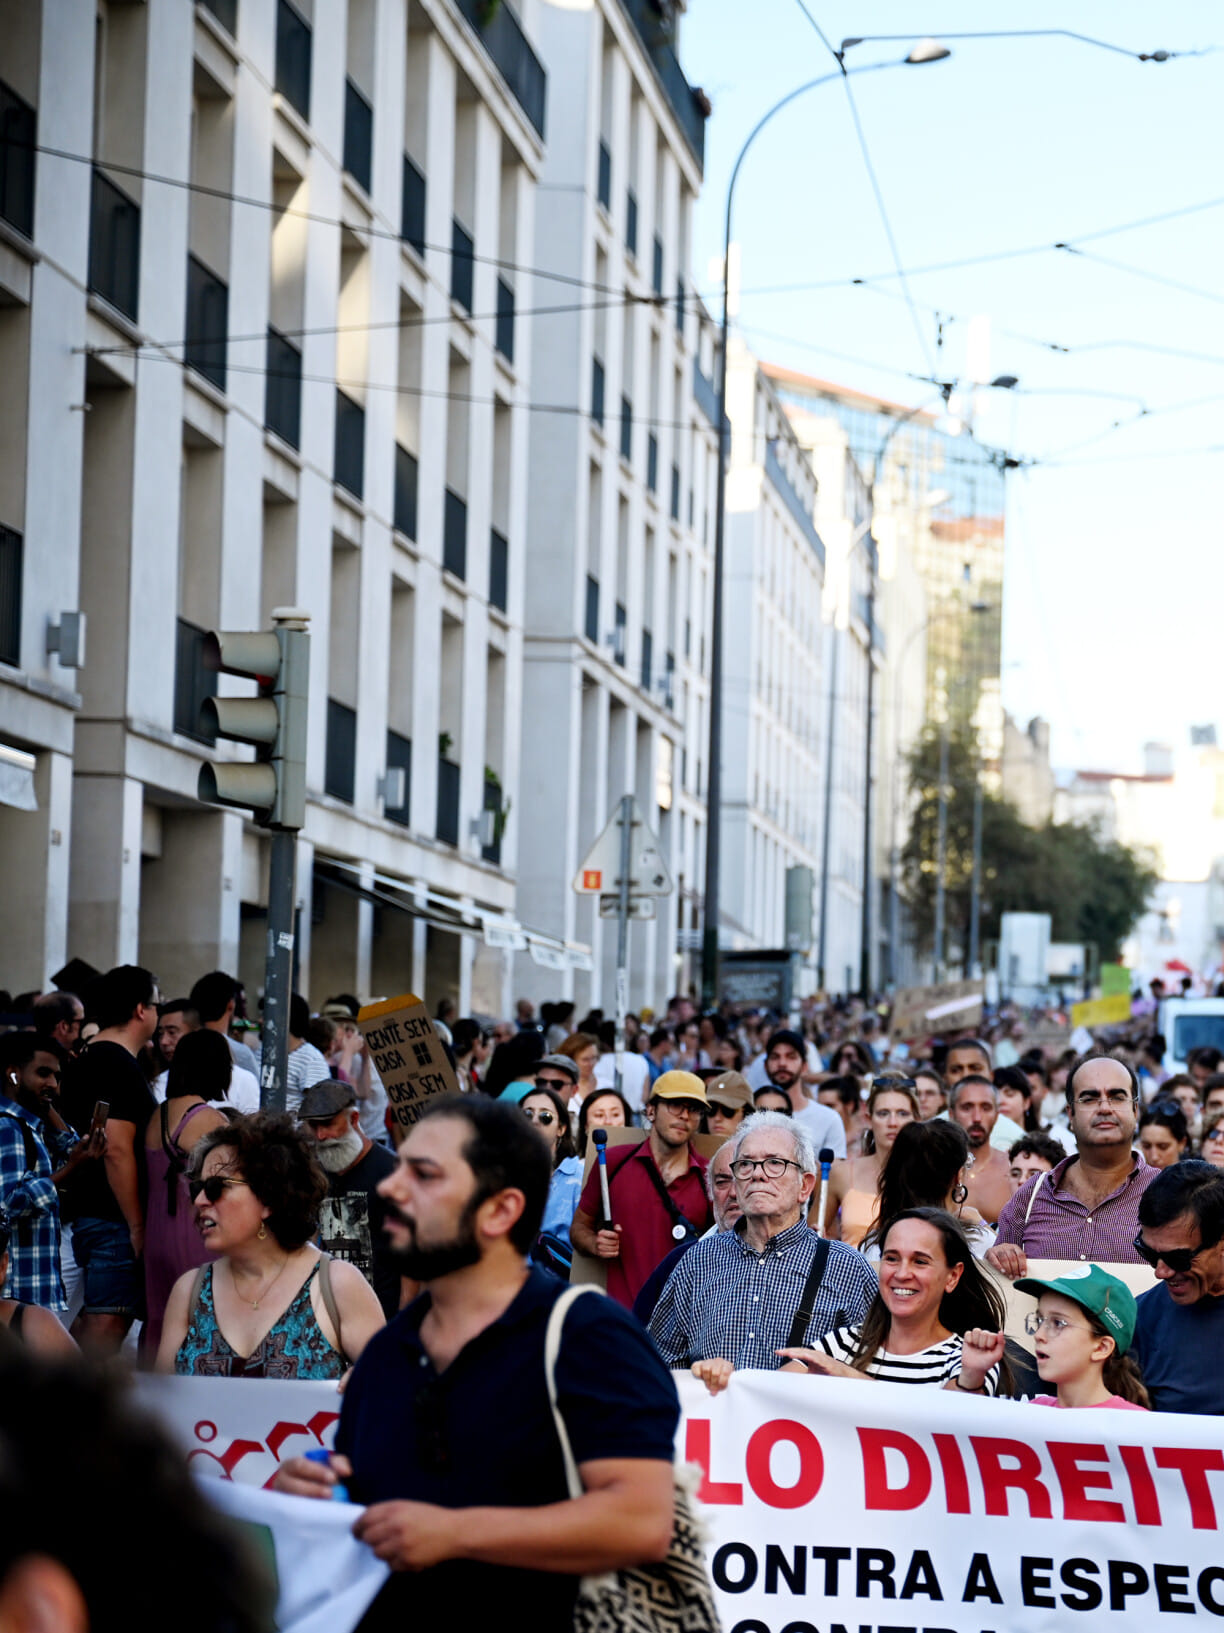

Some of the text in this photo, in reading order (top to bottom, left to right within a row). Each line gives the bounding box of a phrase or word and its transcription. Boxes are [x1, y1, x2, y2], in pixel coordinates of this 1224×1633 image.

[365, 1017, 432, 1051] GENTE SEM
[375, 1049, 407, 1073] CASA
[388, 1072, 448, 1104] CASA SEM
[961, 1552, 1005, 1605] A
